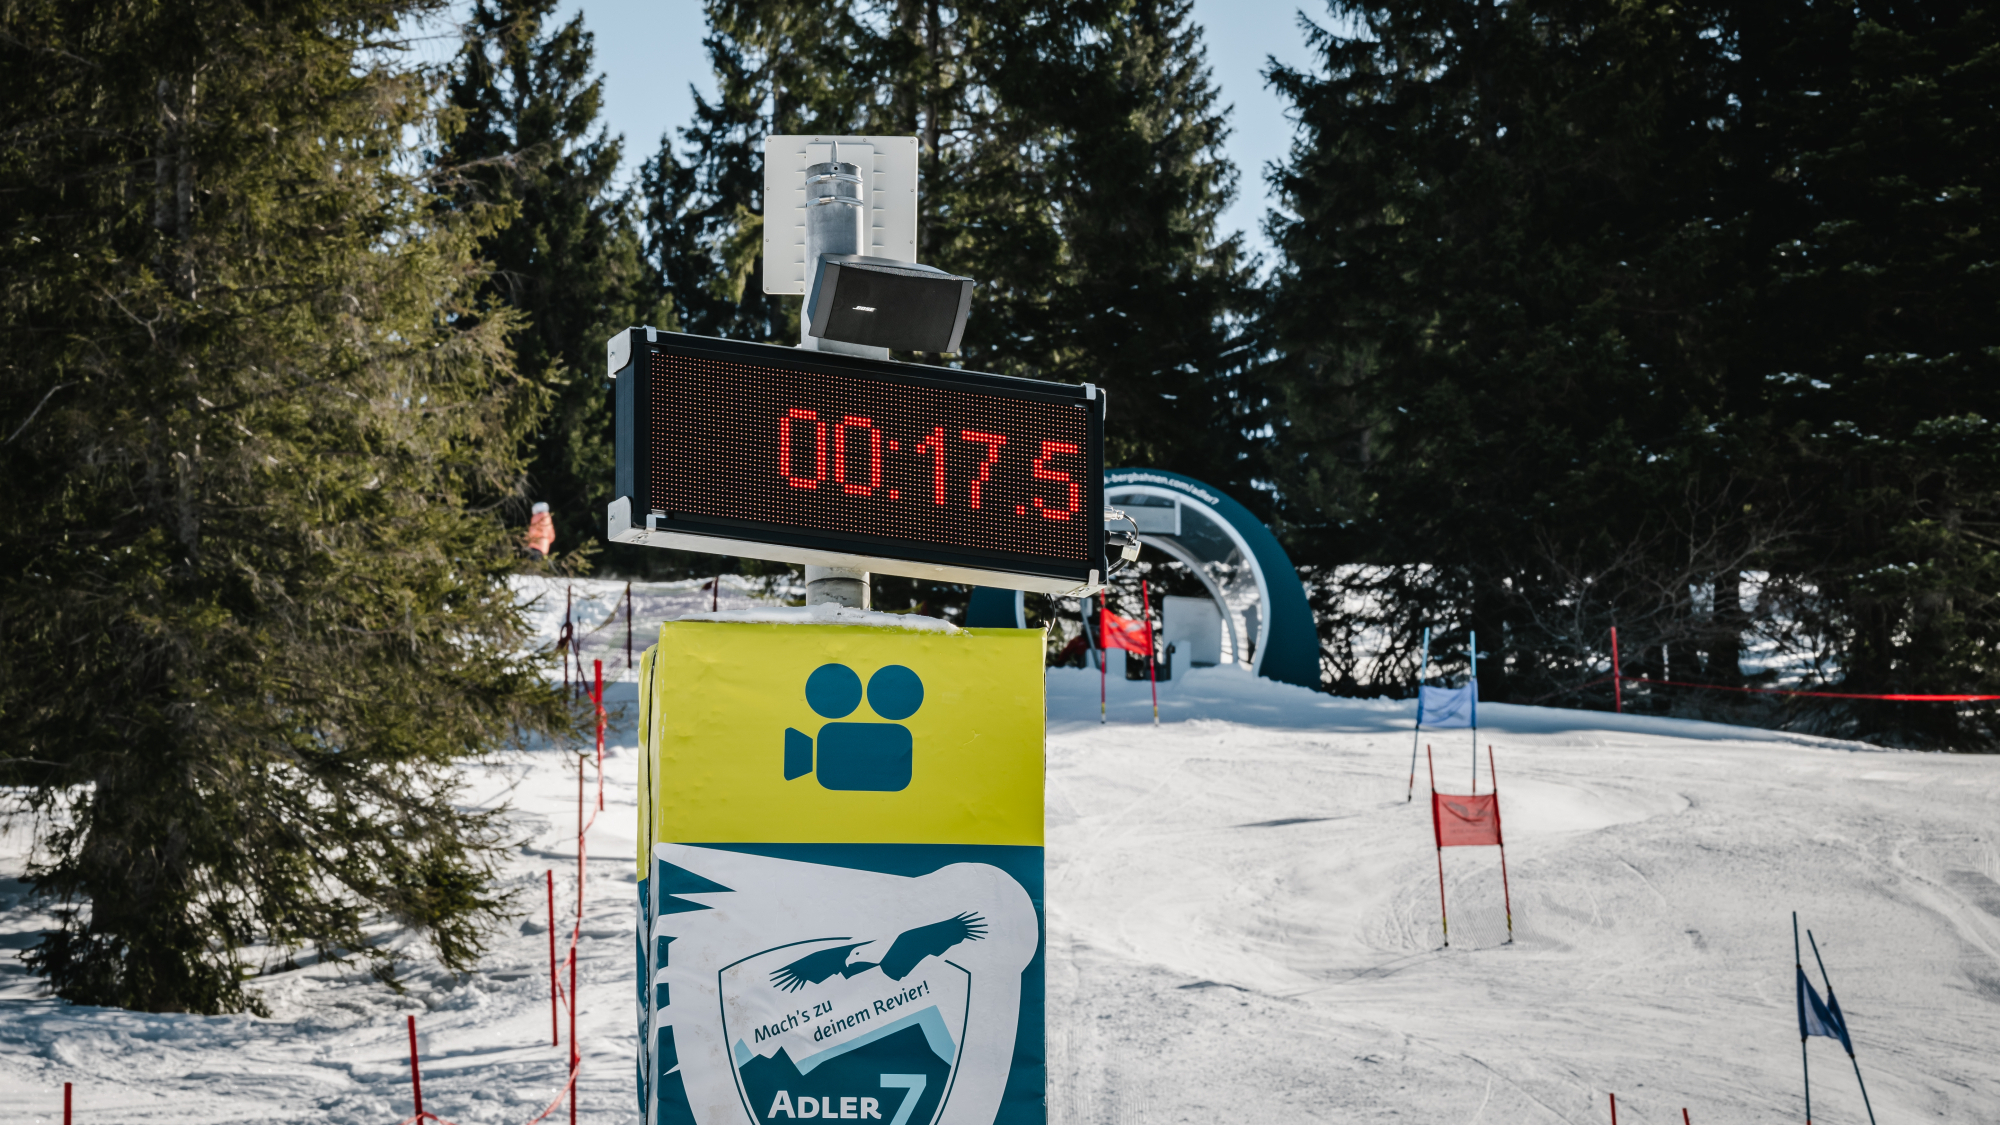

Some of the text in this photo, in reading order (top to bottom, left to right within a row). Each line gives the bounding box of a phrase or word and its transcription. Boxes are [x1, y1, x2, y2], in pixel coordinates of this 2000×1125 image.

[852, 305, 877, 313] BOSE
[779, 407, 1080, 521] 00:17.5
[754, 998, 833, 1044] Mach's zu
[813, 980, 931, 1042] deinem Revier!
[767, 1073, 927, 1125] ADLER 7
